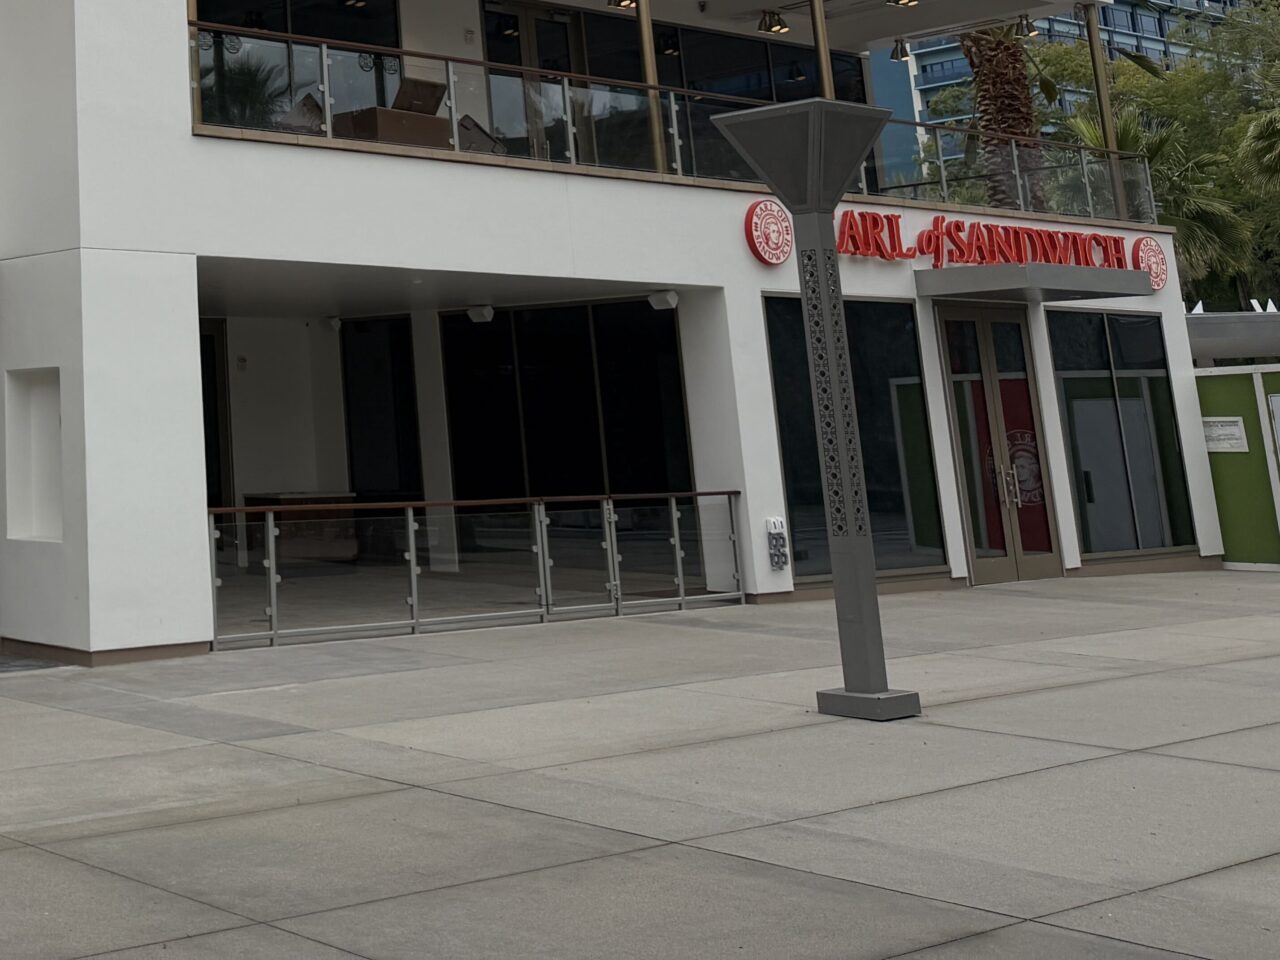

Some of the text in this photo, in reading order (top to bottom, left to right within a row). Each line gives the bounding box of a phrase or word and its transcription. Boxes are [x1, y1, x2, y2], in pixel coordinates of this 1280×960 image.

[755, 203, 789, 222] EARL OF
[755, 235, 791, 261] SANDWICH
[833, 209, 1128, 270] ARL of SANDWICH
